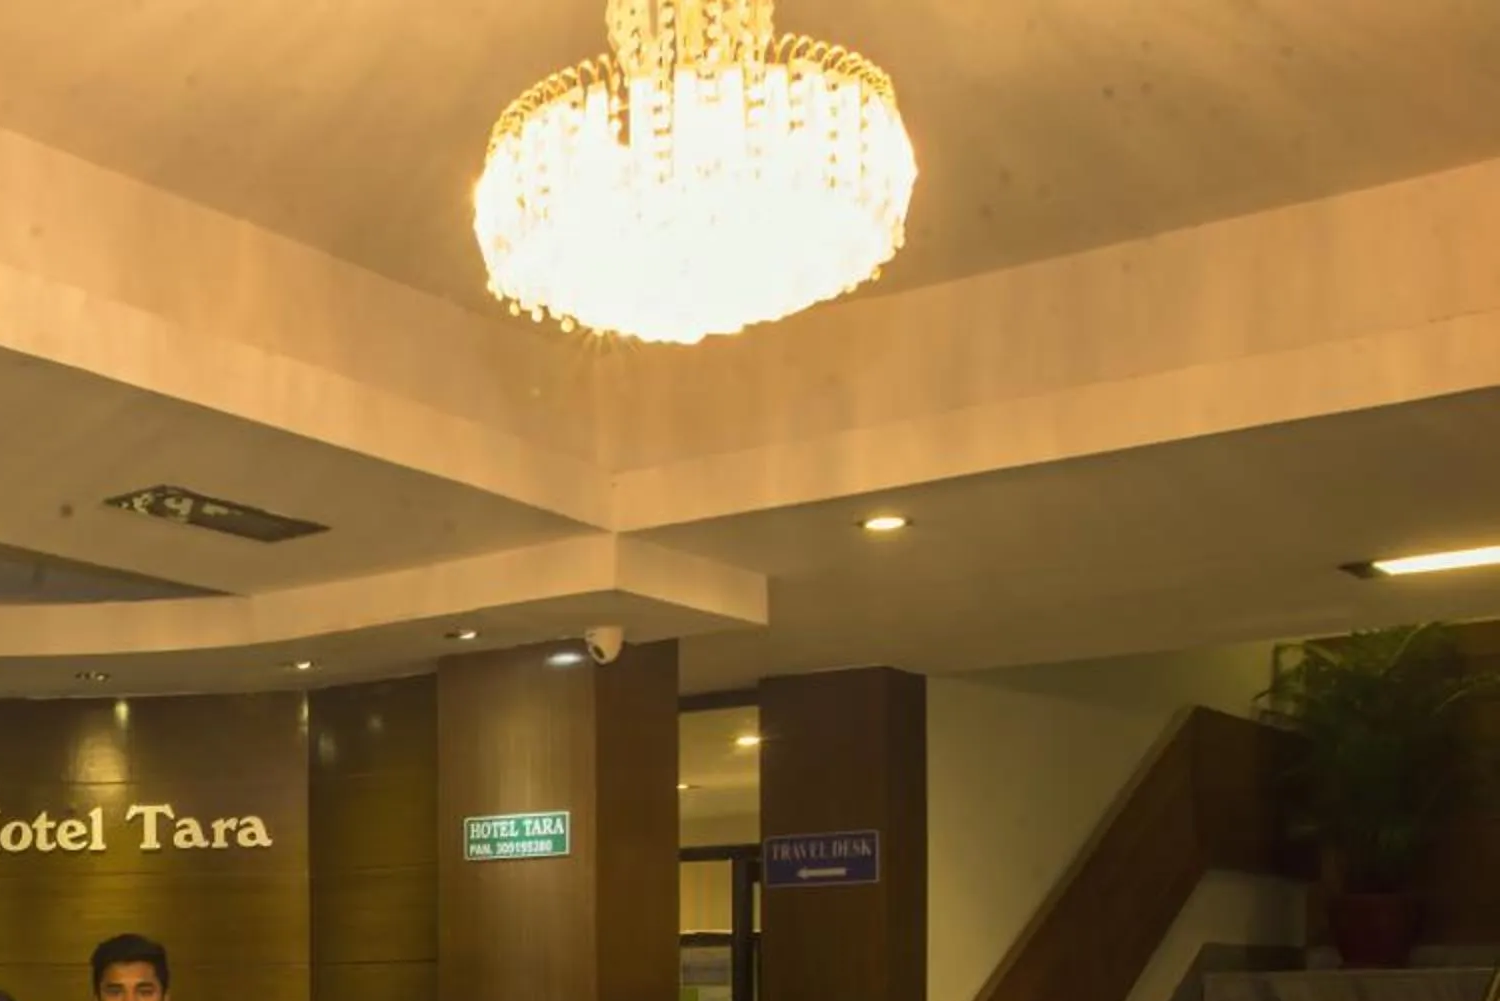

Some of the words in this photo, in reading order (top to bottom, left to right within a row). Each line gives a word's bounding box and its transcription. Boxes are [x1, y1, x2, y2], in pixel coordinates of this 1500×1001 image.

[125, 803, 273, 851] Tara
[469, 820, 519, 839] HOTEL
[522, 818, 565, 837] TARA
[772, 841, 827, 861] TRAVEL
[831, 838, 871, 857] DESK
